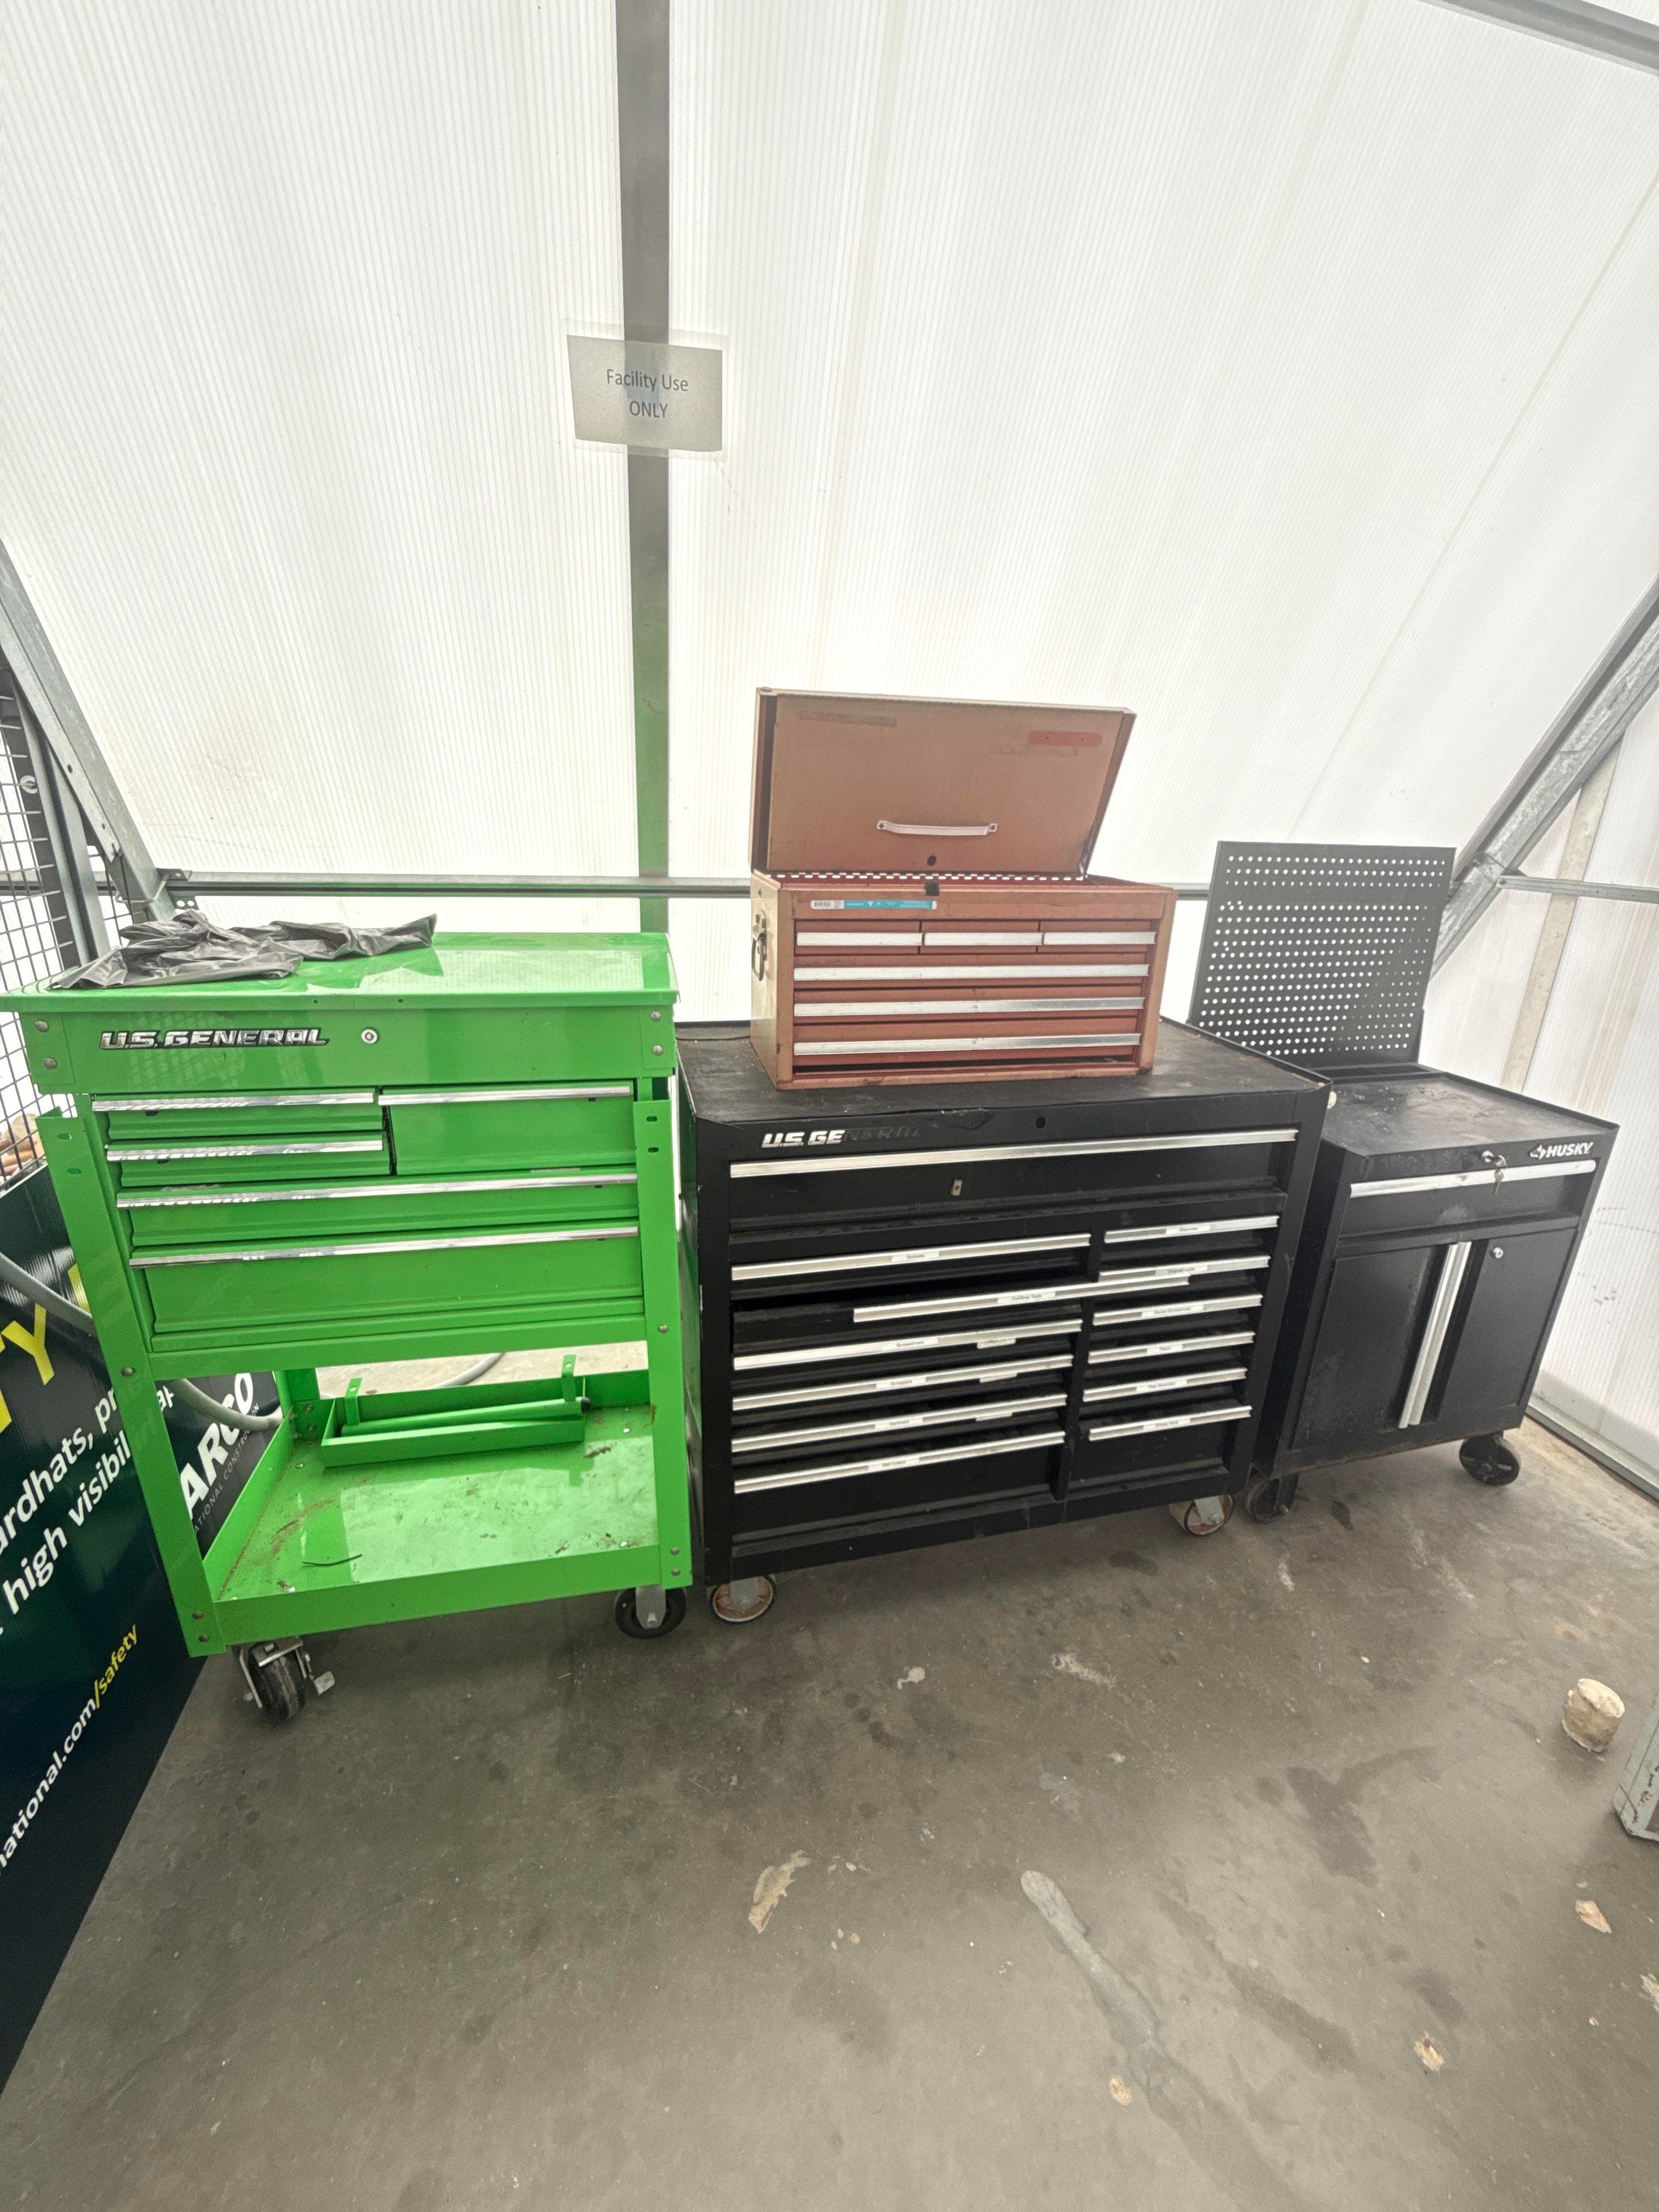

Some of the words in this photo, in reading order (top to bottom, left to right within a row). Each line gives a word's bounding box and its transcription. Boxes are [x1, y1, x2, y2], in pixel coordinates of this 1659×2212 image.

[606, 369, 657, 392] Facility
[662, 374, 689, 391] Use
[629, 400, 668, 418] ONLY
[100, 1031, 158, 1049] U.S.
[164, 1029, 327, 1047] GENERAL
[761, 1132, 805, 1148] U.S.
[1546, 1142, 1594, 1158] HUSKY
[195, 1483, 224, 1533] ATIONAL
[3, 1526, 67, 1615] high
[68, 1430, 131, 1527] visibil
